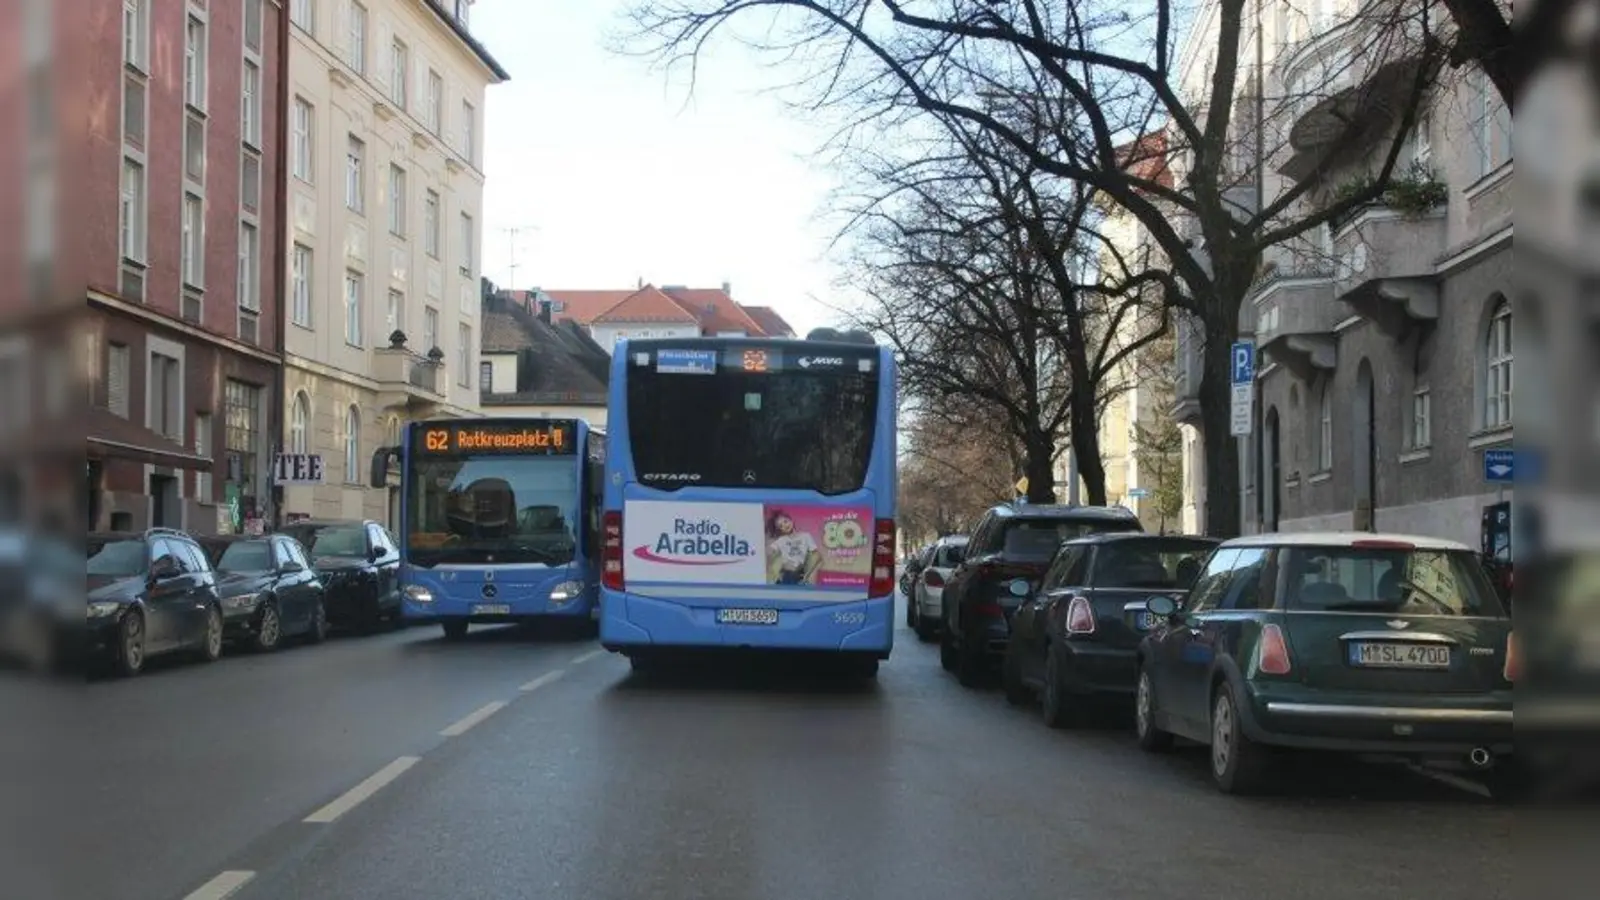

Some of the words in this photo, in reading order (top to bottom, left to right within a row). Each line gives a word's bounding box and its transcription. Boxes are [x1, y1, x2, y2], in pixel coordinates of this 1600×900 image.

[743, 349, 767, 371] 62
[425, 430, 449, 451] 62
[457, 429, 549, 449] Rotkreuzplatz
[275, 453, 322, 480] TEE
[643, 472, 702, 481] CITARO
[674, 519, 721, 536] Radio
[835, 611, 865, 624] 5659
[1382, 645, 1403, 662] SL
[1407, 646, 1448, 664] 4700
